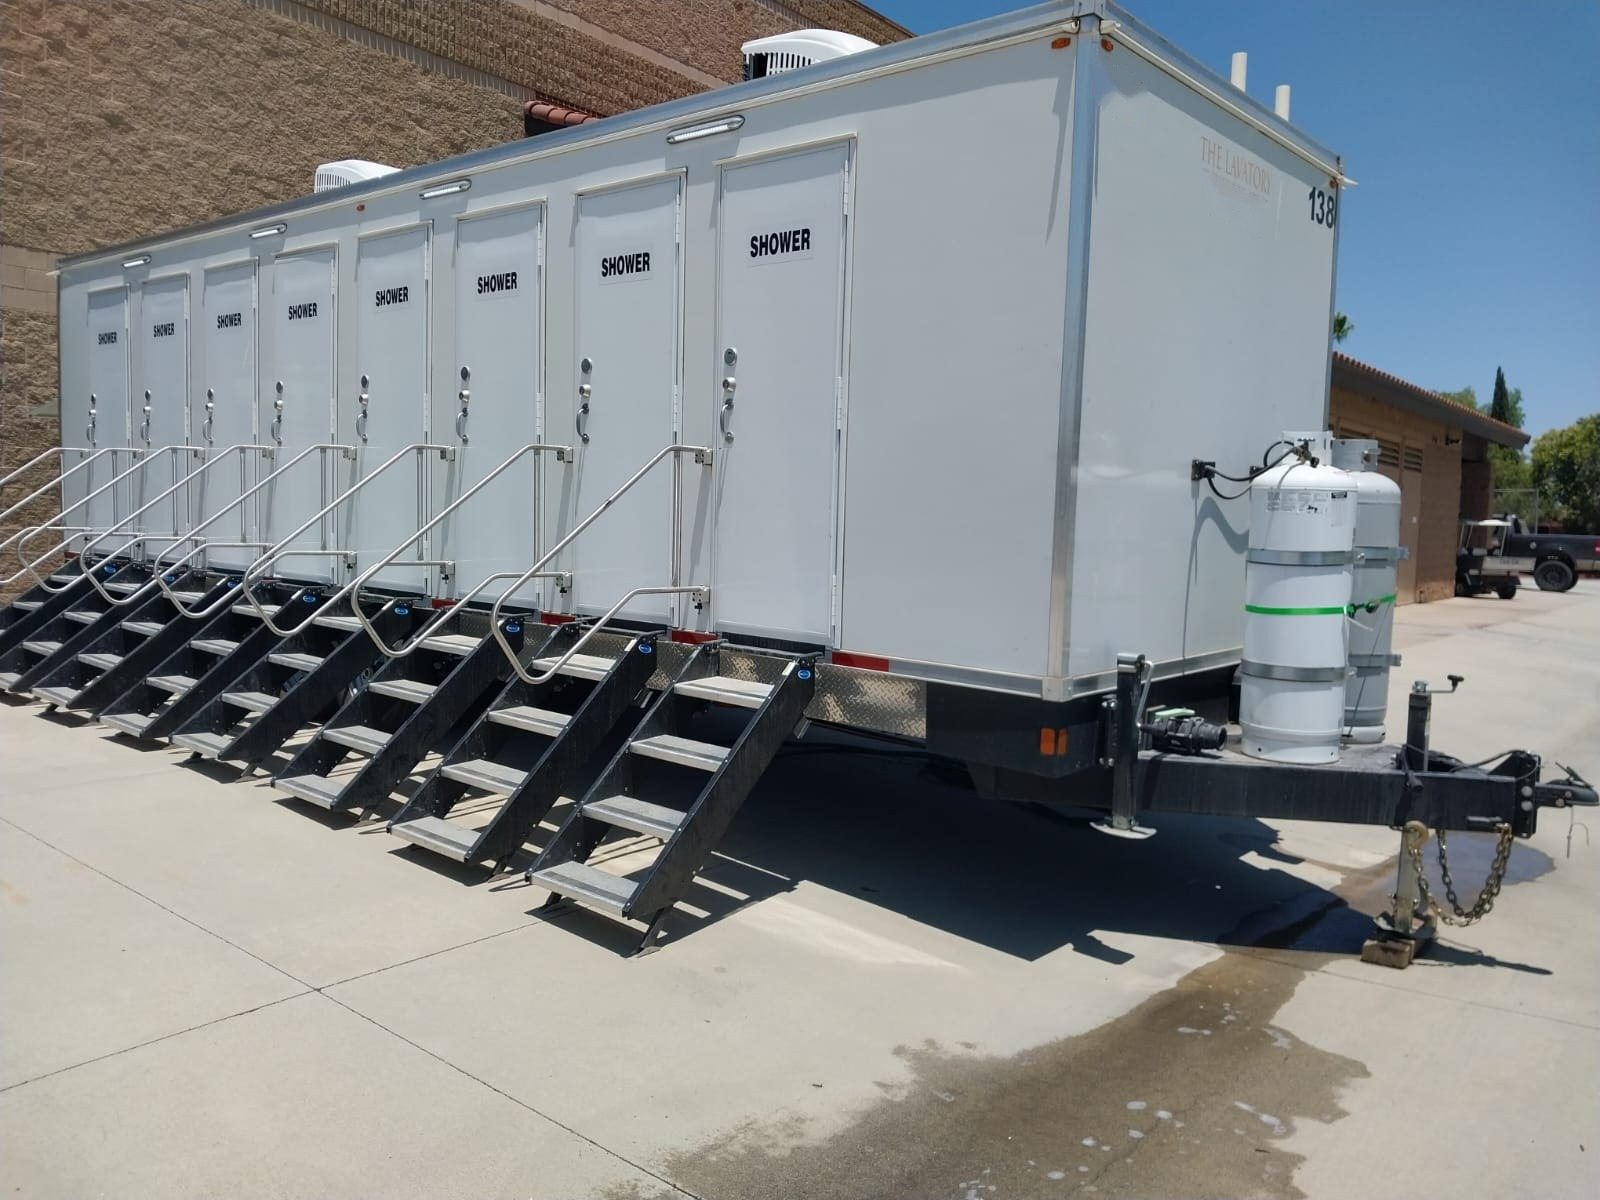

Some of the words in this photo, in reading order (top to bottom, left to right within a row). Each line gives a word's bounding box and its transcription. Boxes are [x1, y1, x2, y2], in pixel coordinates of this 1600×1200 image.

[1200, 136, 1223, 170] THE
[1309, 186, 1335, 229] 138
[750, 228, 811, 258] SHOWER
[601, 252, 651, 277] SHOWER
[477, 271, 518, 294] SHOWER
[375, 286, 409, 307] SHOWER
[217, 312, 242, 329] SHOWER
[288, 302, 318, 320] SHOWER
[97, 331, 118, 345] SHOWER
[153, 322, 175, 338] SHOWER
